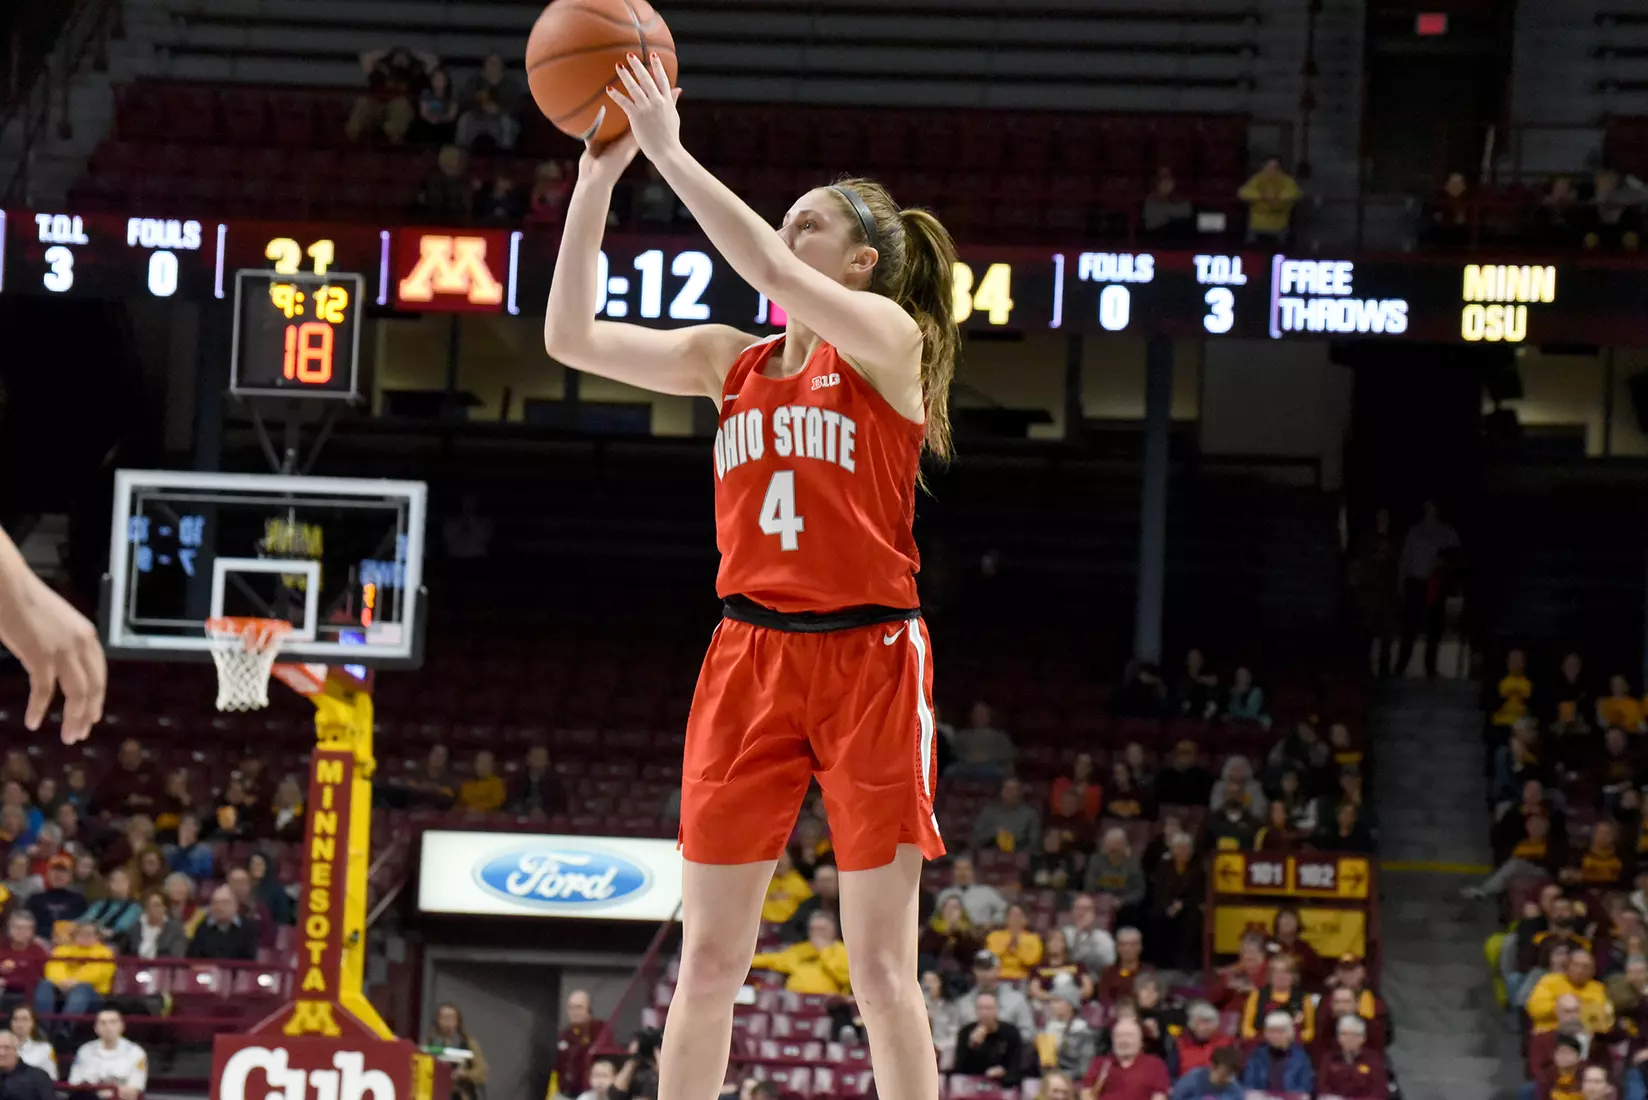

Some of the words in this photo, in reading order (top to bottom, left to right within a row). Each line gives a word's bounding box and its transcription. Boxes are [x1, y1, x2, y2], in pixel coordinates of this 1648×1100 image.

[127, 217, 201, 250] FOULS
[43, 246, 74, 292] 3
[148, 250, 178, 297] 0
[1078, 252, 1155, 283] FOULS
[1280, 260, 1354, 295] FREE
[1462, 264, 1557, 303] MINN
[271, 283, 349, 324] 9:12
[1099, 284, 1131, 331] 0
[1203, 287, 1235, 334] 3
[1279, 297, 1409, 334] THROWS
[1461, 303, 1528, 342] OSU
[283, 321, 334, 384] 18
[715, 407, 765, 482] OHIO
[772, 404, 857, 475] STATE
[758, 469, 804, 551] 4
[302, 758, 344, 992] MINNESOTA
[505, 852, 619, 900] Ford
[1249, 861, 1284, 886] 101
[1299, 863, 1336, 888] 102
